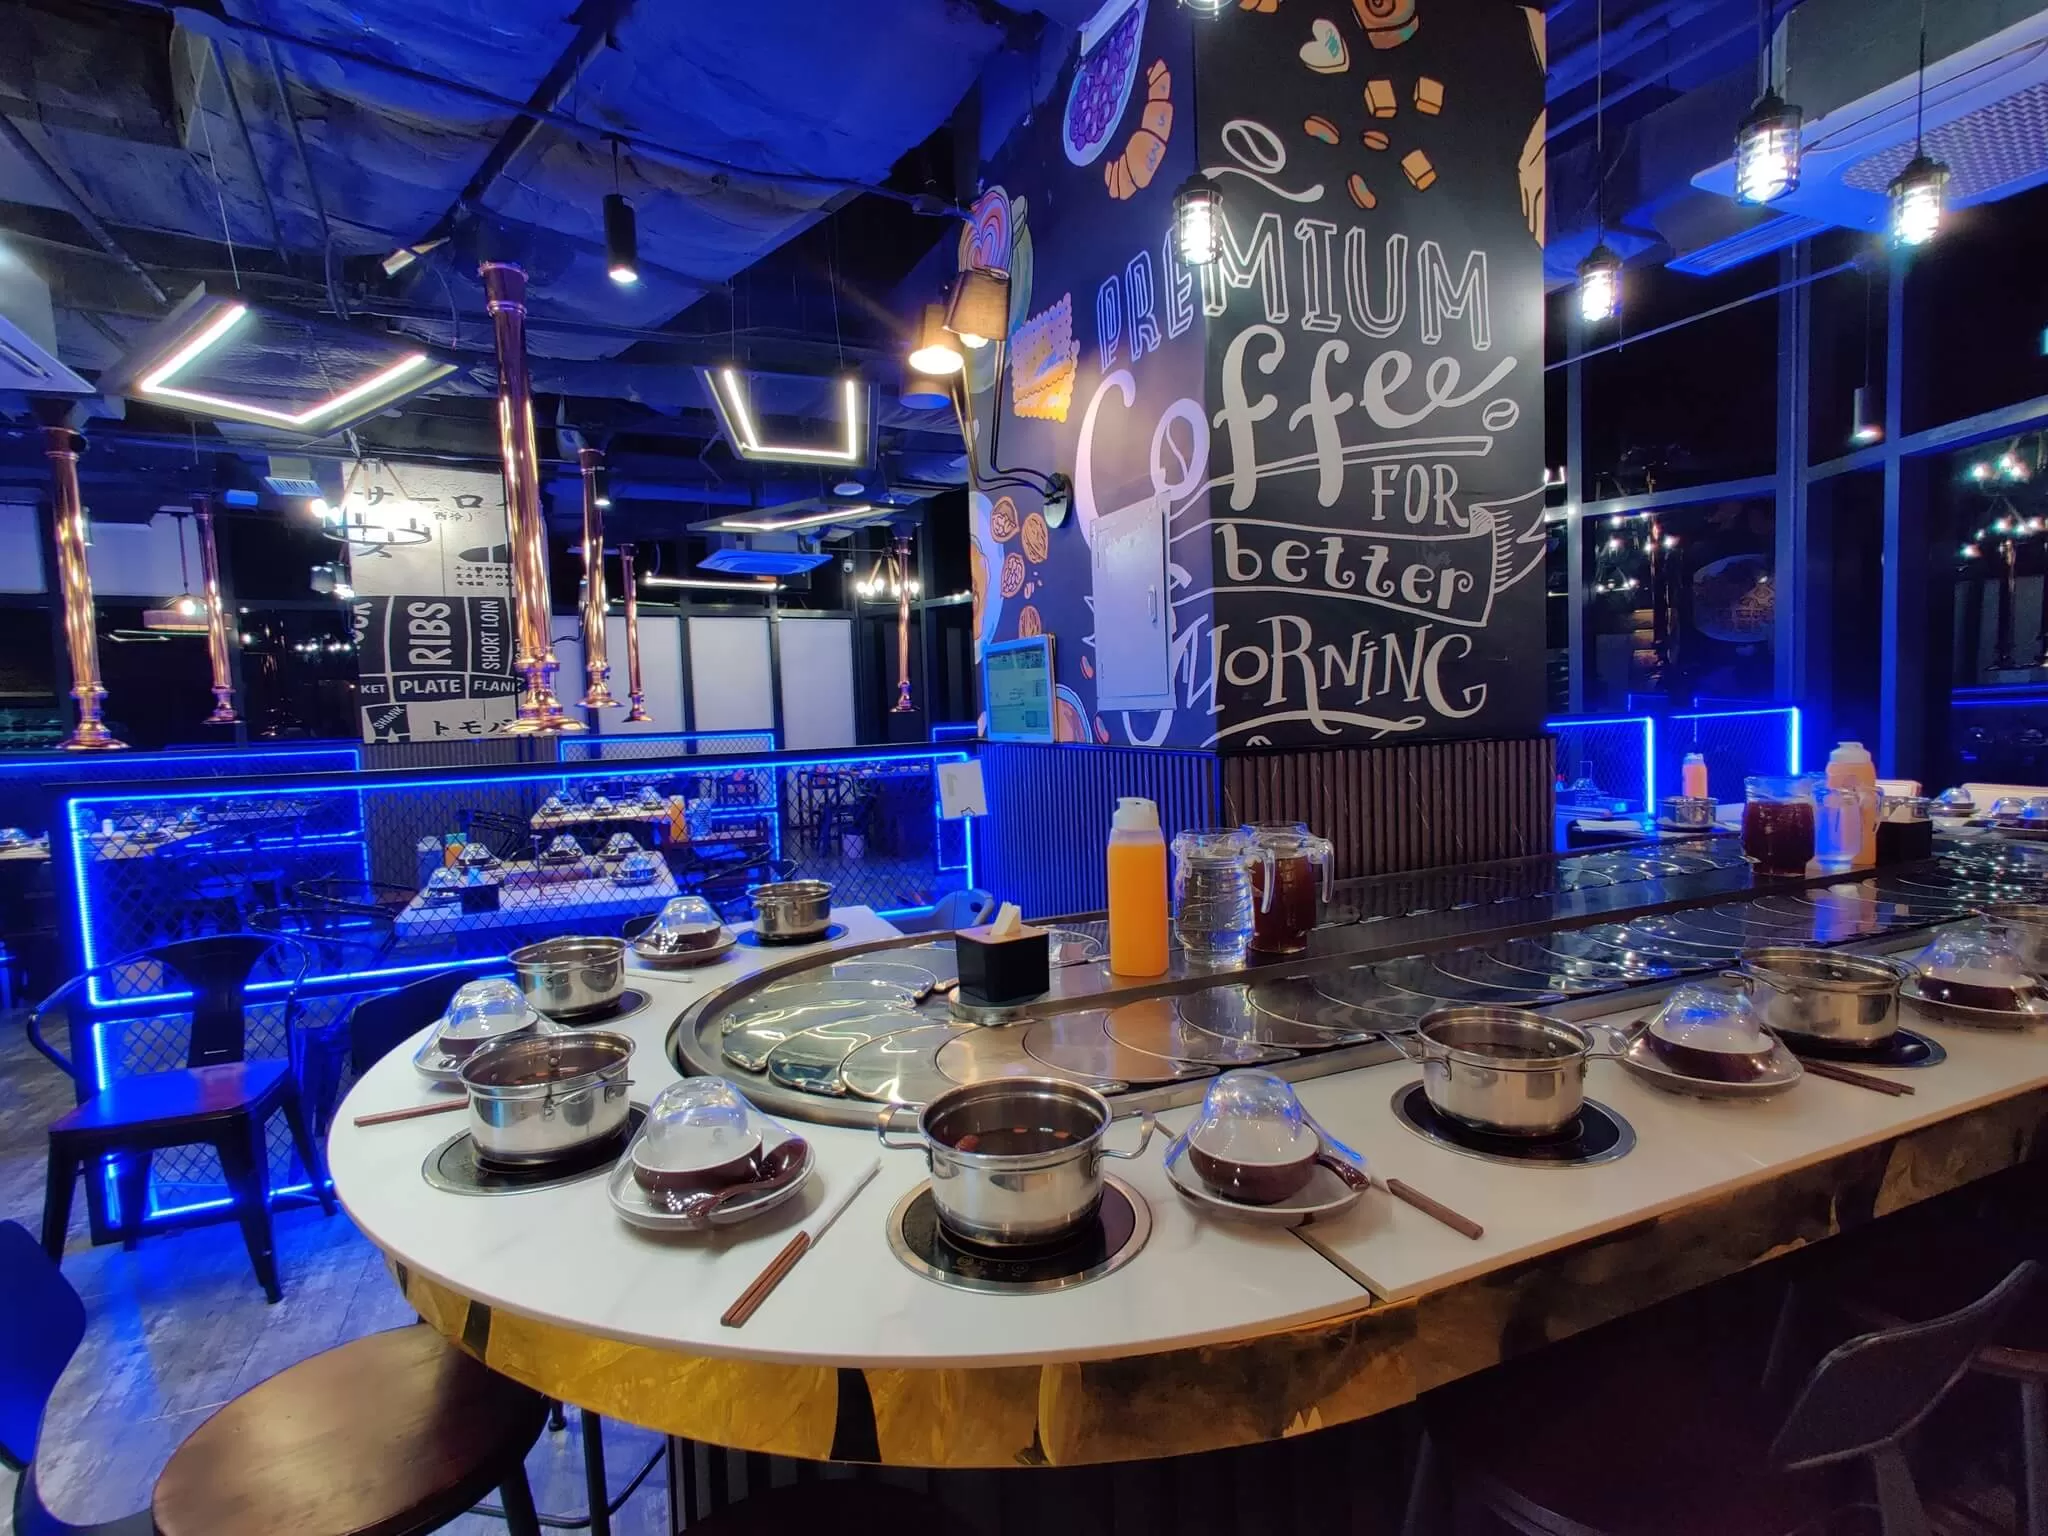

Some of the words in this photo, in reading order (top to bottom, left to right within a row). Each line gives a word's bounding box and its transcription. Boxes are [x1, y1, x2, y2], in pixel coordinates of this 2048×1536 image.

[1097, 212, 1491, 374] PREMIUM
[1075, 324, 1518, 552] Coffee
[353, 486, 507, 509] サーロ
[1371, 464, 1469, 529] FOR
[1214, 523, 1475, 609] better
[407, 601, 452, 666] RIBS
[479, 600, 501, 629] LOIN
[480, 632, 501, 671] SHORT
[400, 678, 462, 695] PLATE
[373, 704, 406, 731] SHANK
